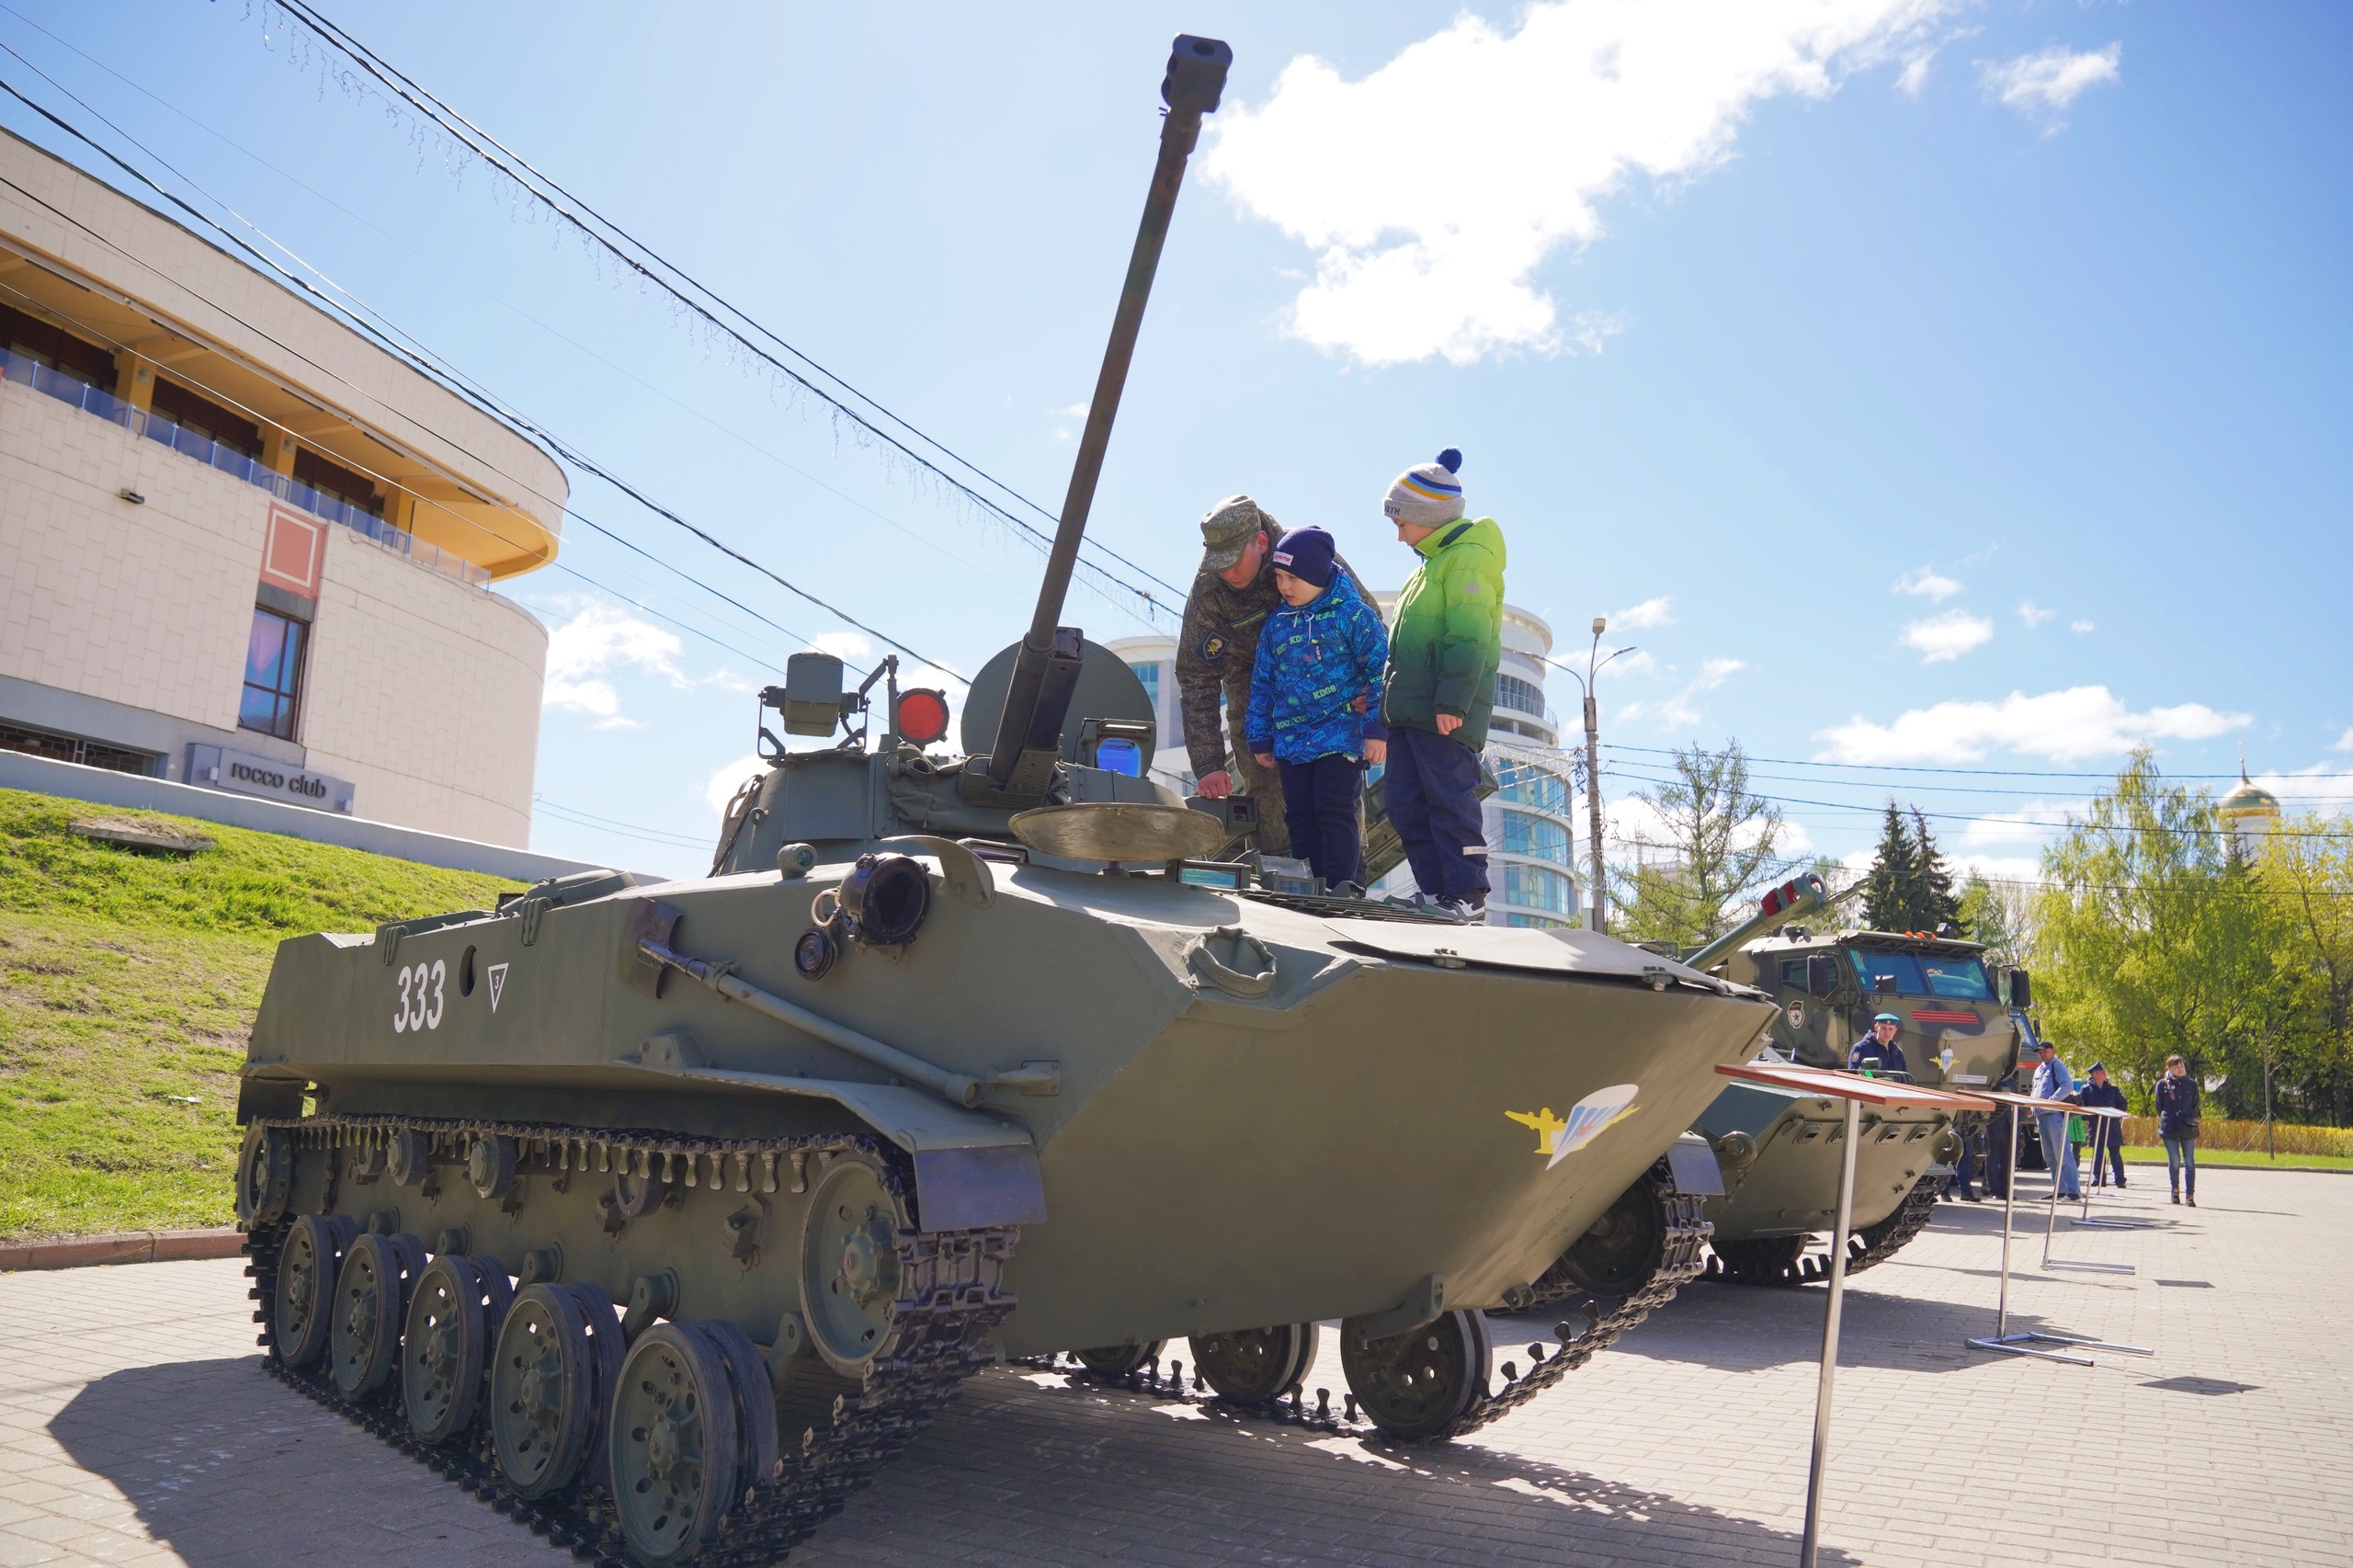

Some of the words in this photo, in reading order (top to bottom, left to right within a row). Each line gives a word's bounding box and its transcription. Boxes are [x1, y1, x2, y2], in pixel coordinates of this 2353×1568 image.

[231, 762, 285, 789] rocco
[289, 774, 327, 799] club
[393, 960, 446, 1033] 333
[494, 974, 501, 990] 3
